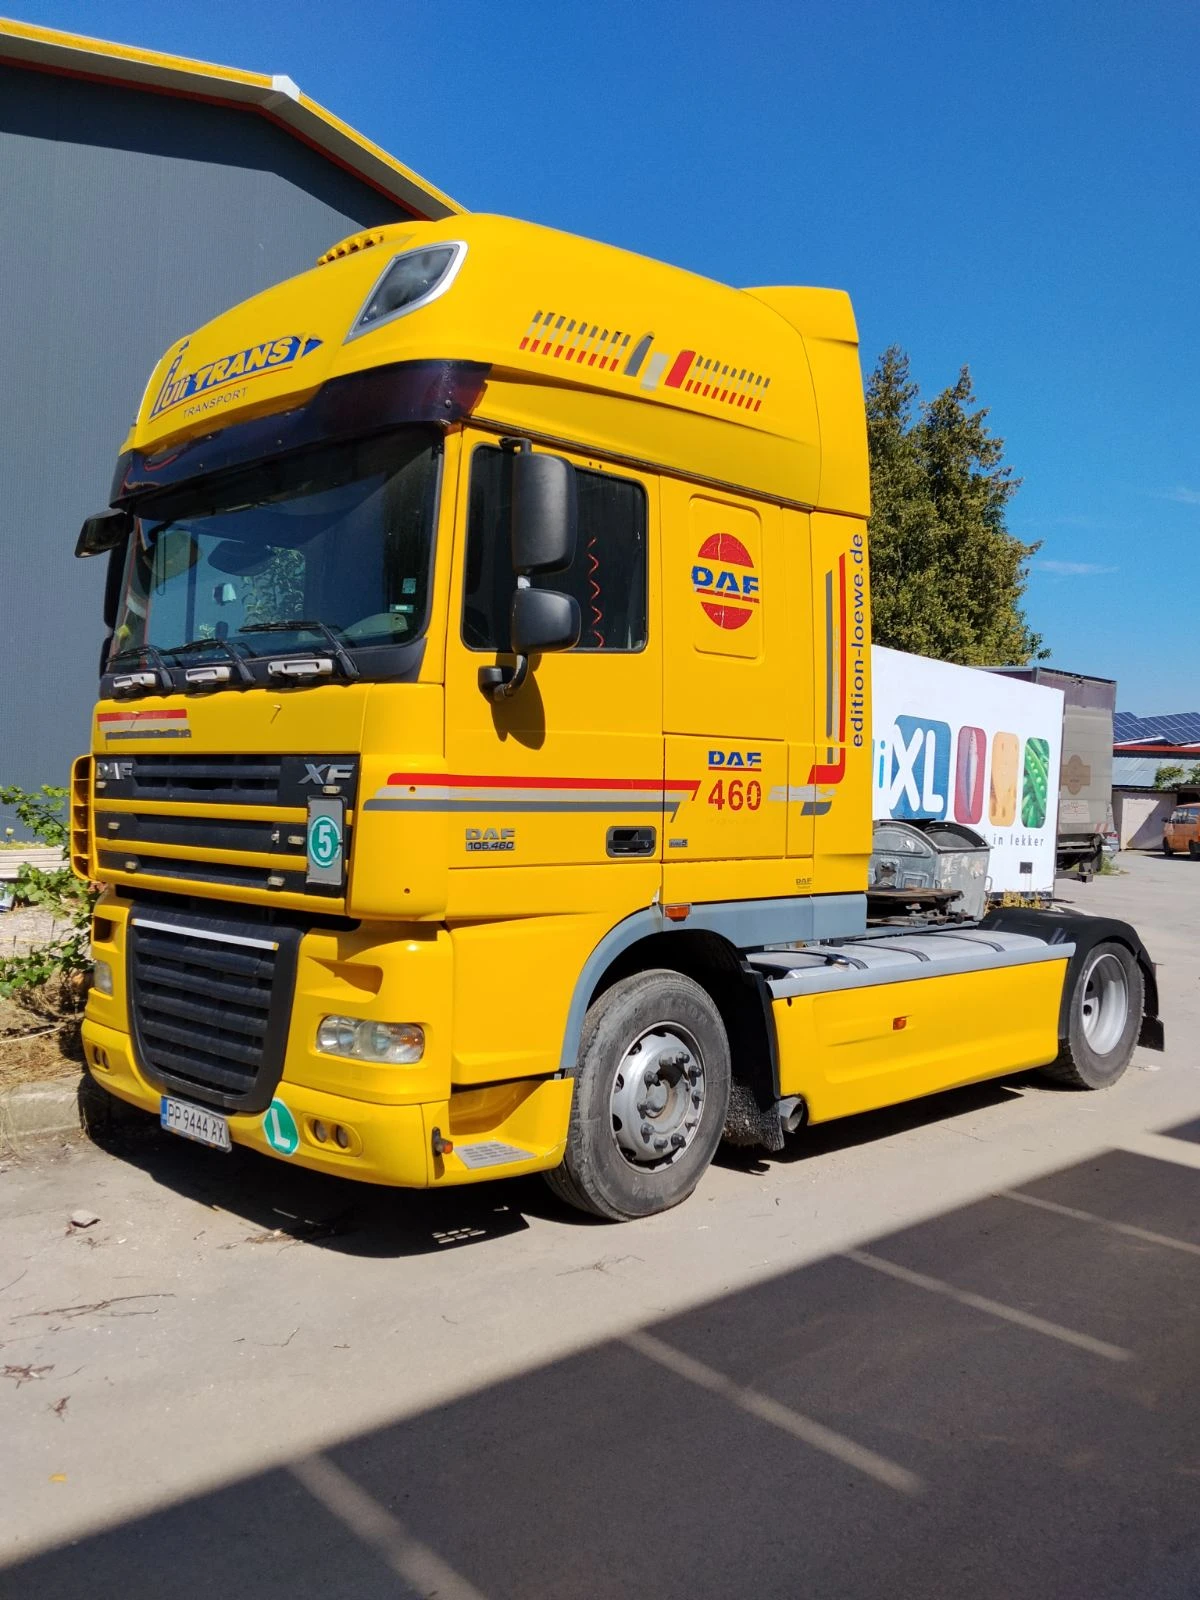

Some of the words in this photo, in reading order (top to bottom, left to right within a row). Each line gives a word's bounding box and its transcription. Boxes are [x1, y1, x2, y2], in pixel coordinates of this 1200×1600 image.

[194, 336, 296, 391] TRANS
[183, 386, 248, 419] TRANSPORT
[691, 565, 759, 594] DAF
[850, 533, 864, 747] edition-loewe.de
[96, 762, 132, 780] DAF
[708, 751, 762, 766] DAF
[298, 763, 354, 785] XF
[708, 780, 762, 811] 460
[318, 824, 332, 859] 5
[465, 828, 515, 840] DAF
[467, 841, 514, 850] 105.460
[1011, 834, 1044, 847] lekker
[184, 1109, 208, 1138] 9444
[271, 1107, 290, 1148] L
